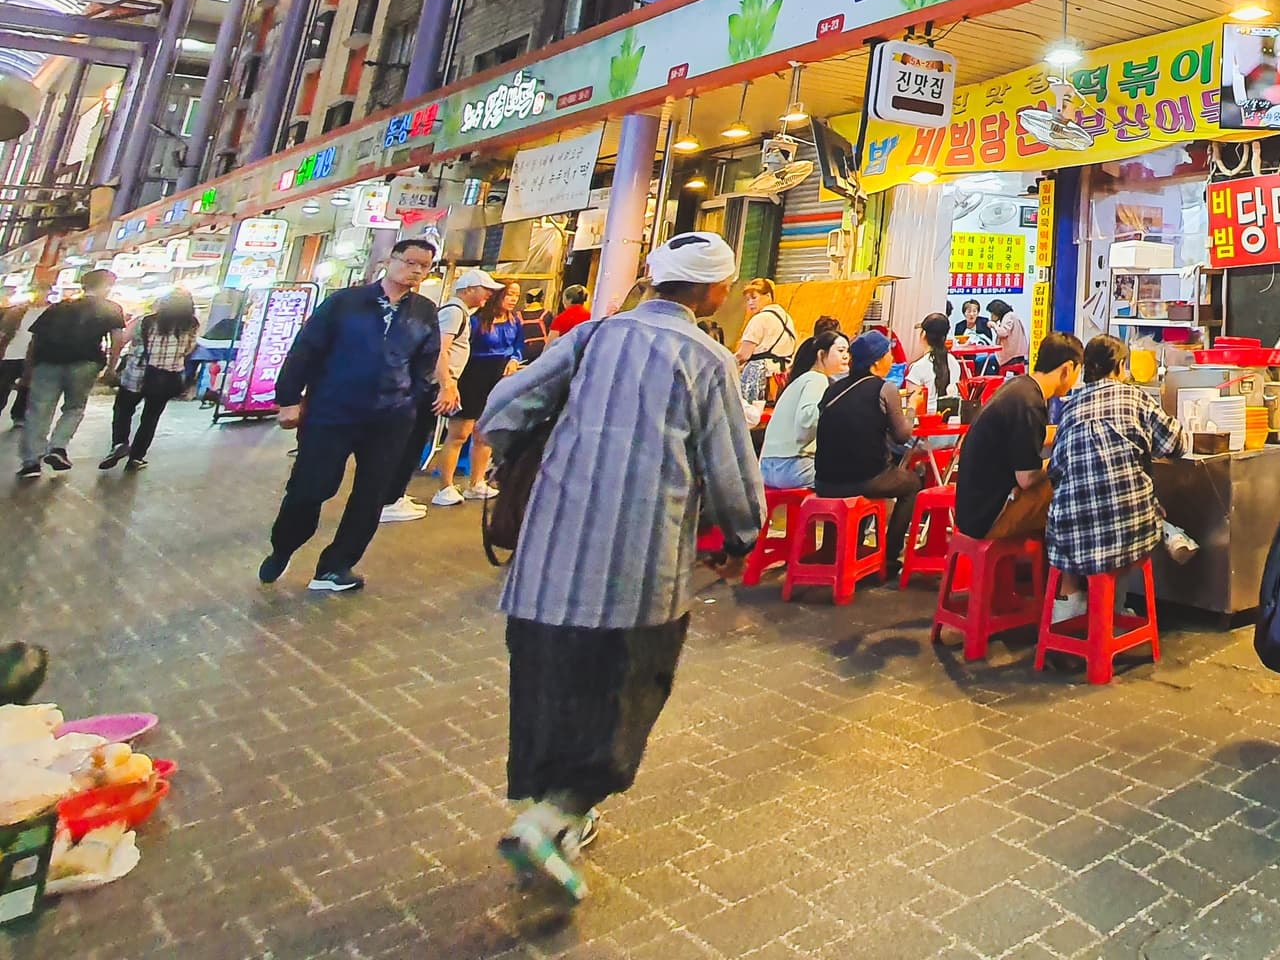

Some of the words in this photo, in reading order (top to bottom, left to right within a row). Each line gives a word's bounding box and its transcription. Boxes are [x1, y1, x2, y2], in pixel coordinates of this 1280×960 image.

[895, 70, 945, 100] 진맛집
[1070, 40, 1214, 103] 떡볶이
[1212, 187, 1235, 259] 비빔
